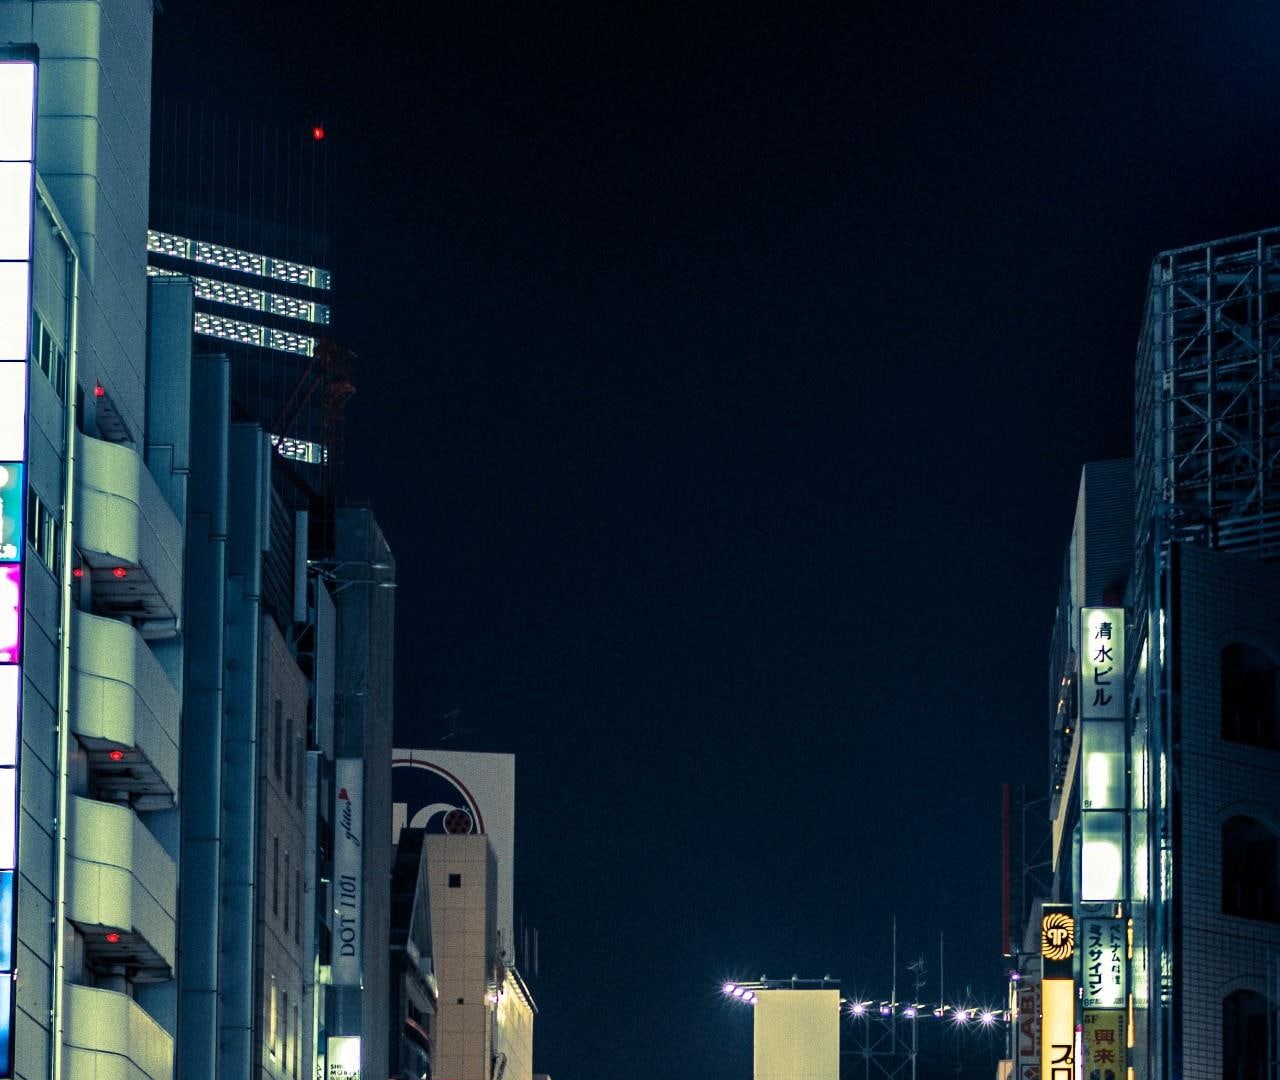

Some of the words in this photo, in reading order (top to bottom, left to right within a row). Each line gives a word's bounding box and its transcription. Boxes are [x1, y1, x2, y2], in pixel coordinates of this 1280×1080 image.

[1094, 621, 1113, 708] 清水ビル
[340, 913, 357, 957] DOT
